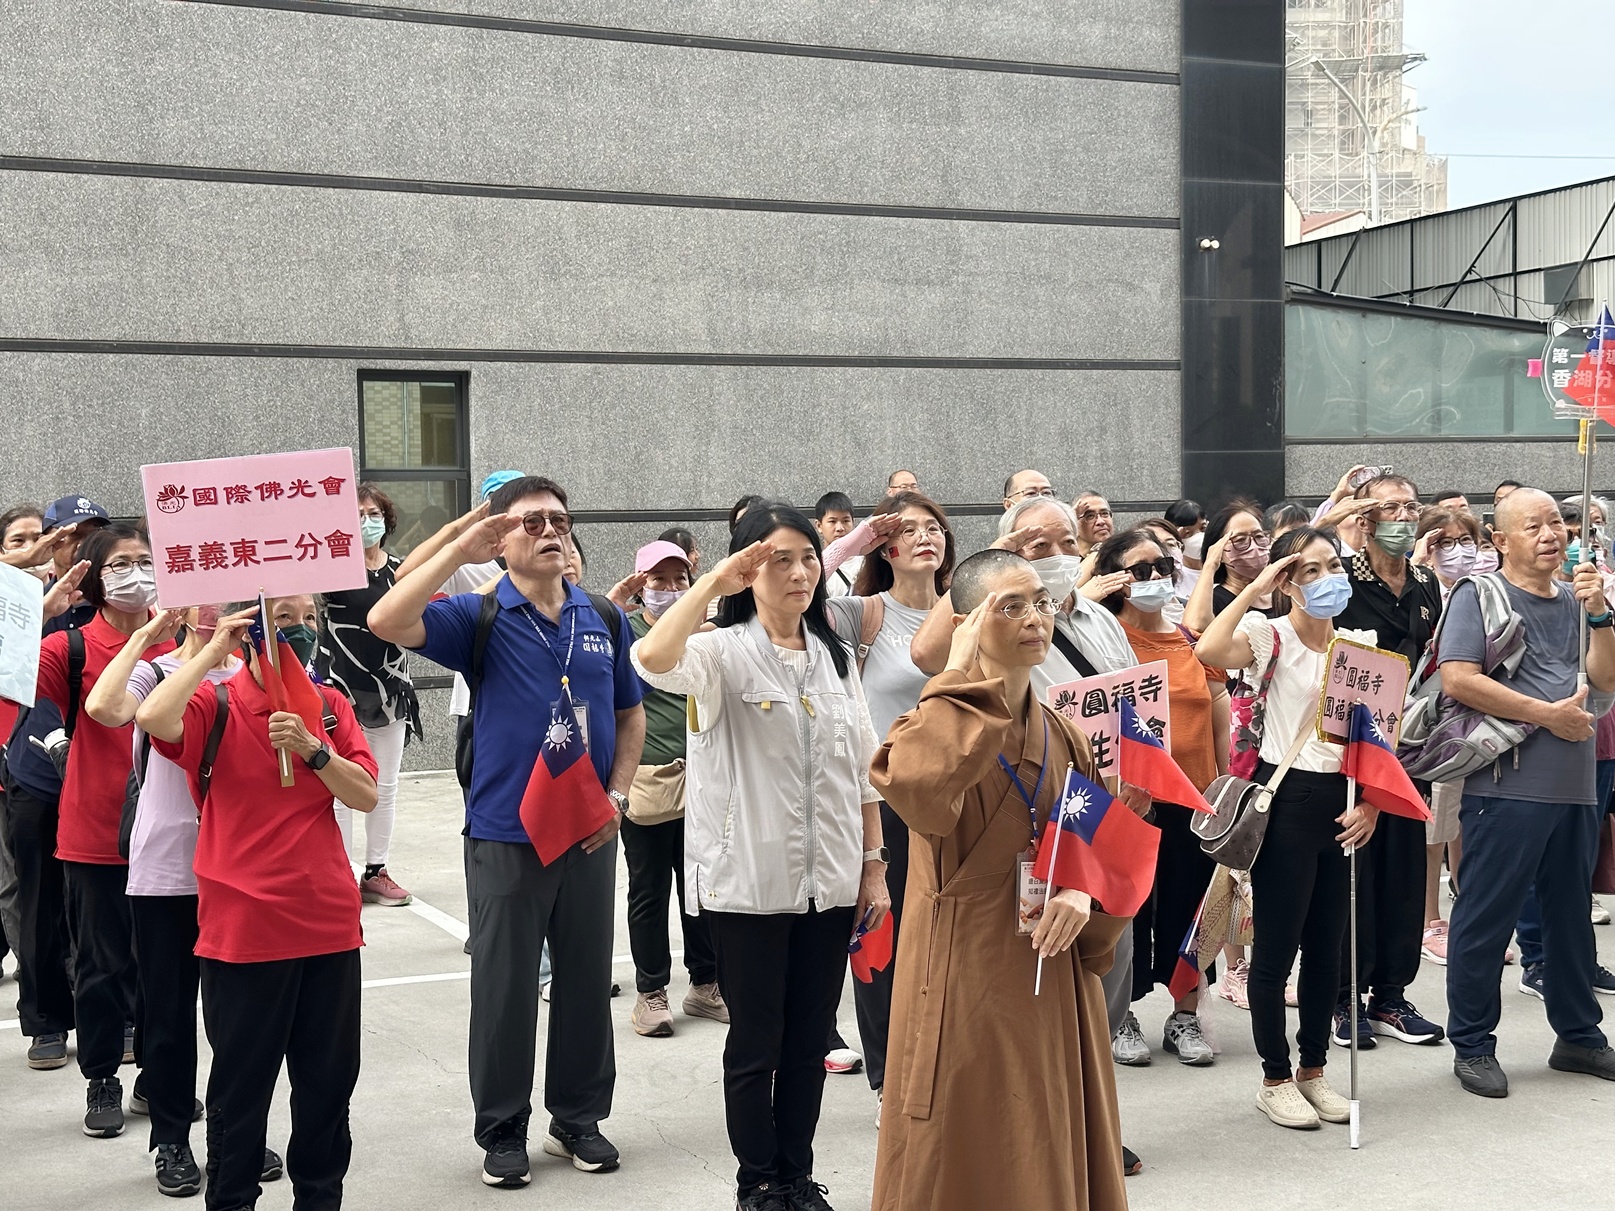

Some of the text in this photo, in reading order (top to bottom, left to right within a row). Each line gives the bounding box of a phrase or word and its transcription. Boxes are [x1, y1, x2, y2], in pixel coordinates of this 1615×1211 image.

[192, 475, 347, 507] 國際佛光會
[165, 529, 354, 575] 嘉義東二分會
[1081, 673, 1163, 718] 圓福寺
[1346, 666, 1385, 695] 圓福寺
[831, 703, 847, 758] 劉美鳳
